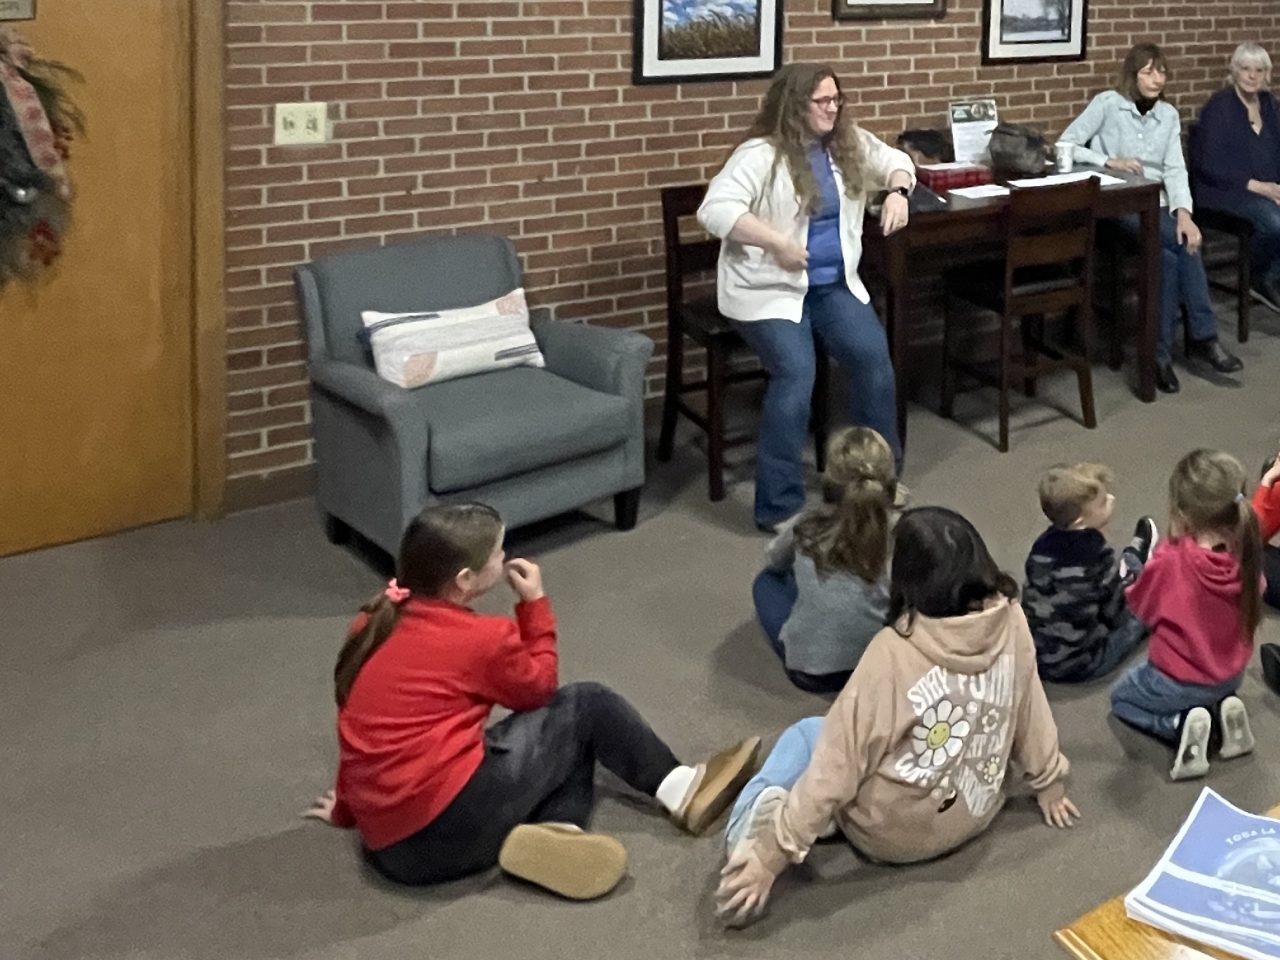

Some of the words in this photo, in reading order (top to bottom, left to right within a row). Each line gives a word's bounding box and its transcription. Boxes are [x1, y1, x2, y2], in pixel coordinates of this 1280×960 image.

[907, 665, 951, 716] STAY
[1225, 830, 1258, 845] TODA
[1261, 827, 1276, 835] LA
